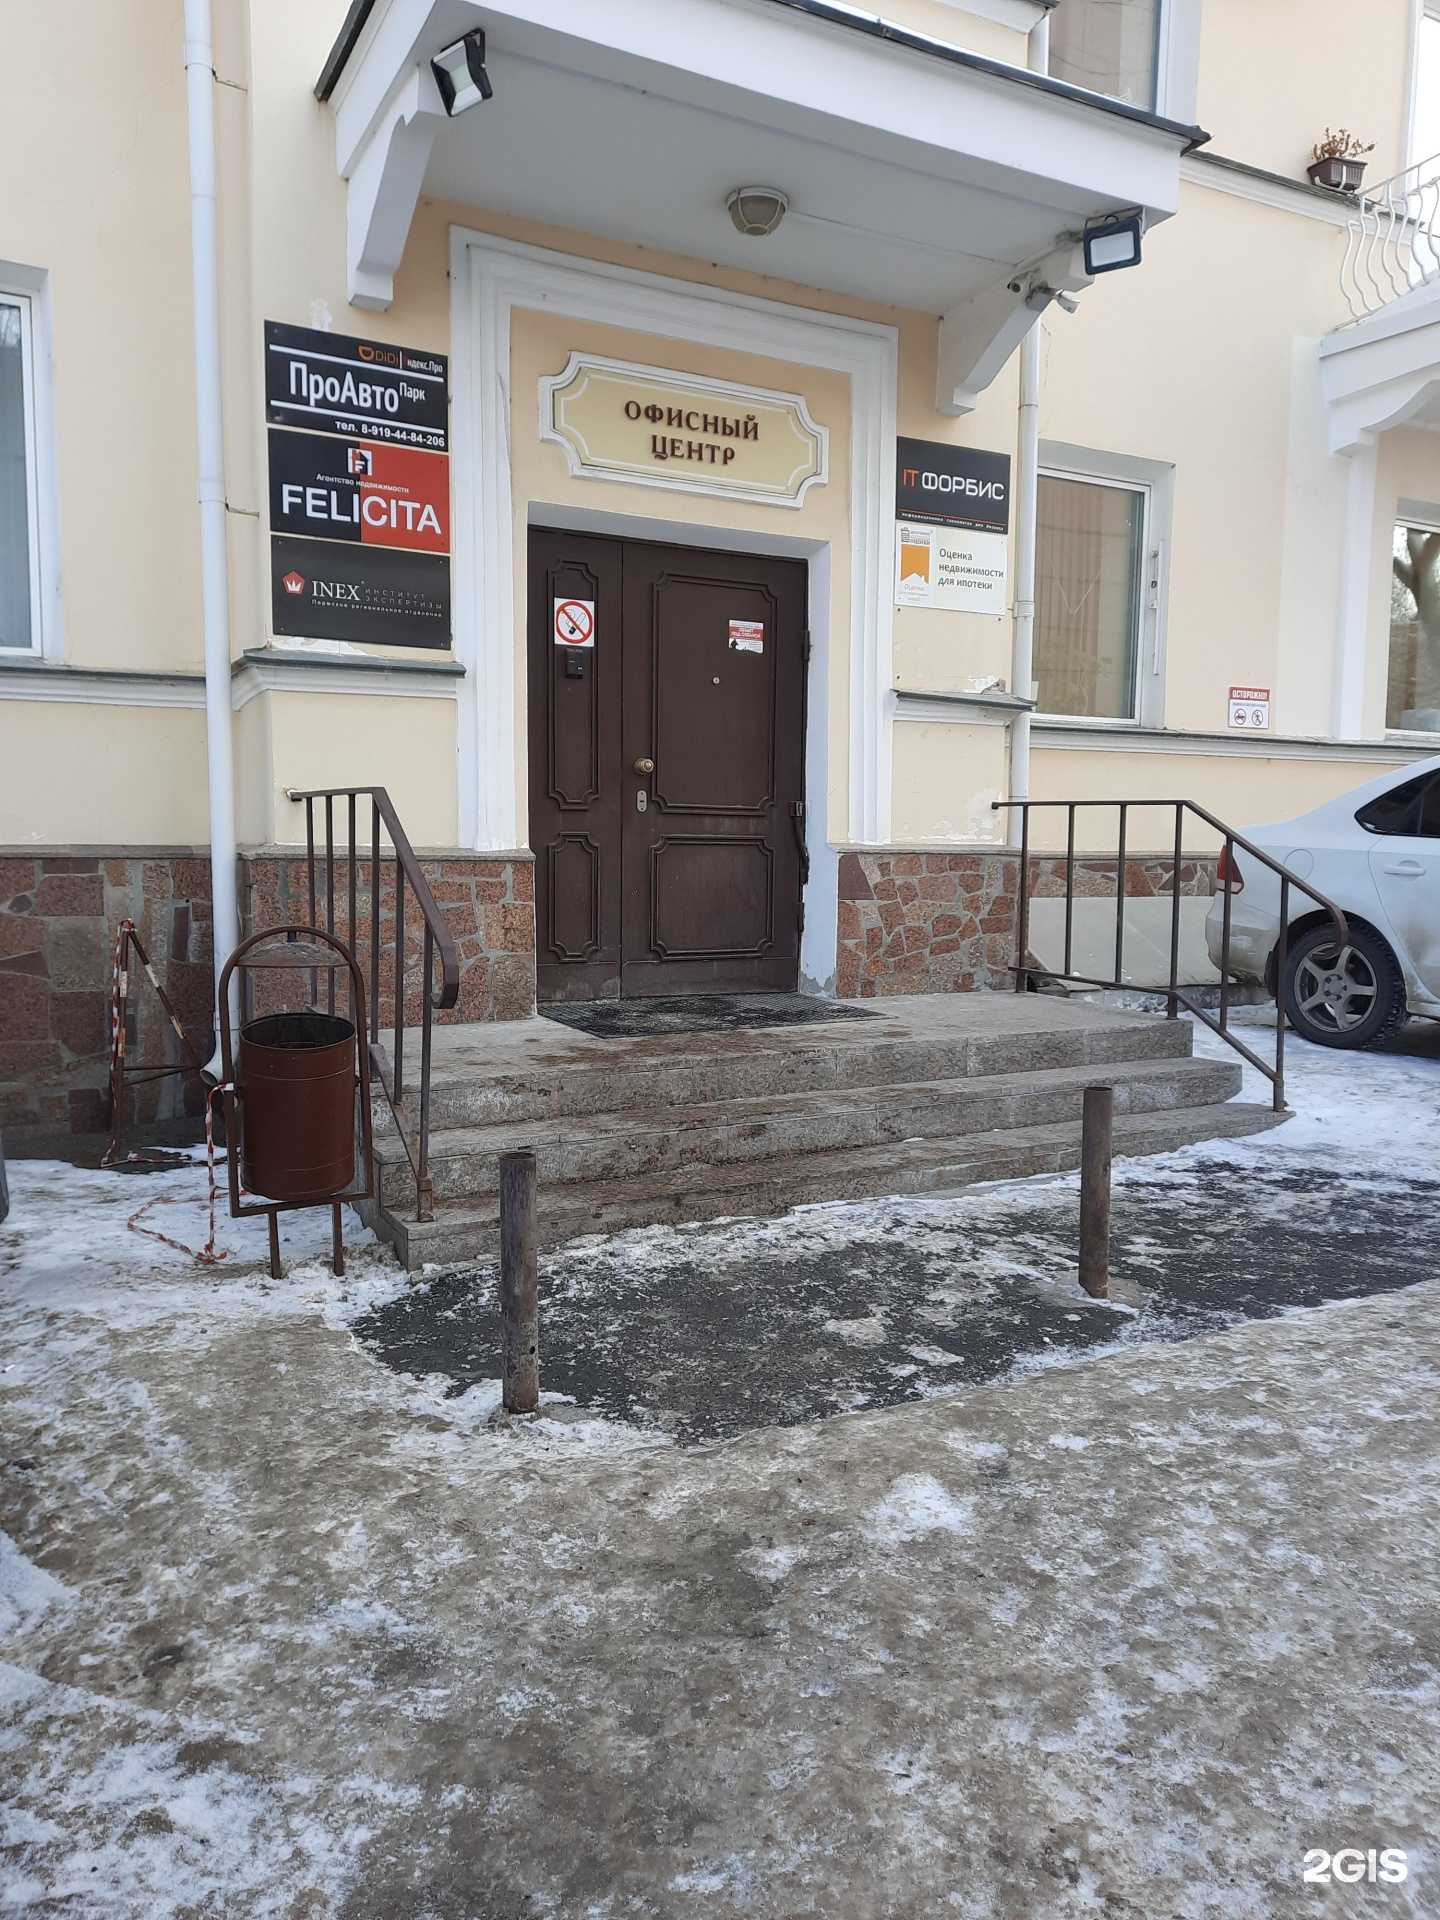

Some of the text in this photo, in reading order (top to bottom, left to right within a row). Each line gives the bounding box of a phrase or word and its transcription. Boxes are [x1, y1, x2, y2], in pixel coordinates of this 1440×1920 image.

[624, 400, 759, 441] ОФИСНЫЙ
[335, 420, 445, 447] тел. 8-919-44-84-206
[651, 434, 736, 465] ЦЕНТР
[316, 473, 354, 486] Агентство
[903, 468, 1005, 500] IT ФОРБИС
[282, 483, 442, 534] FELICITA
[939, 548, 973, 561] Оценка
[938, 563, 1004, 578] недвижимости
[312, 580, 360, 601] INEX
[938, 577, 992, 590] для ипотеки
